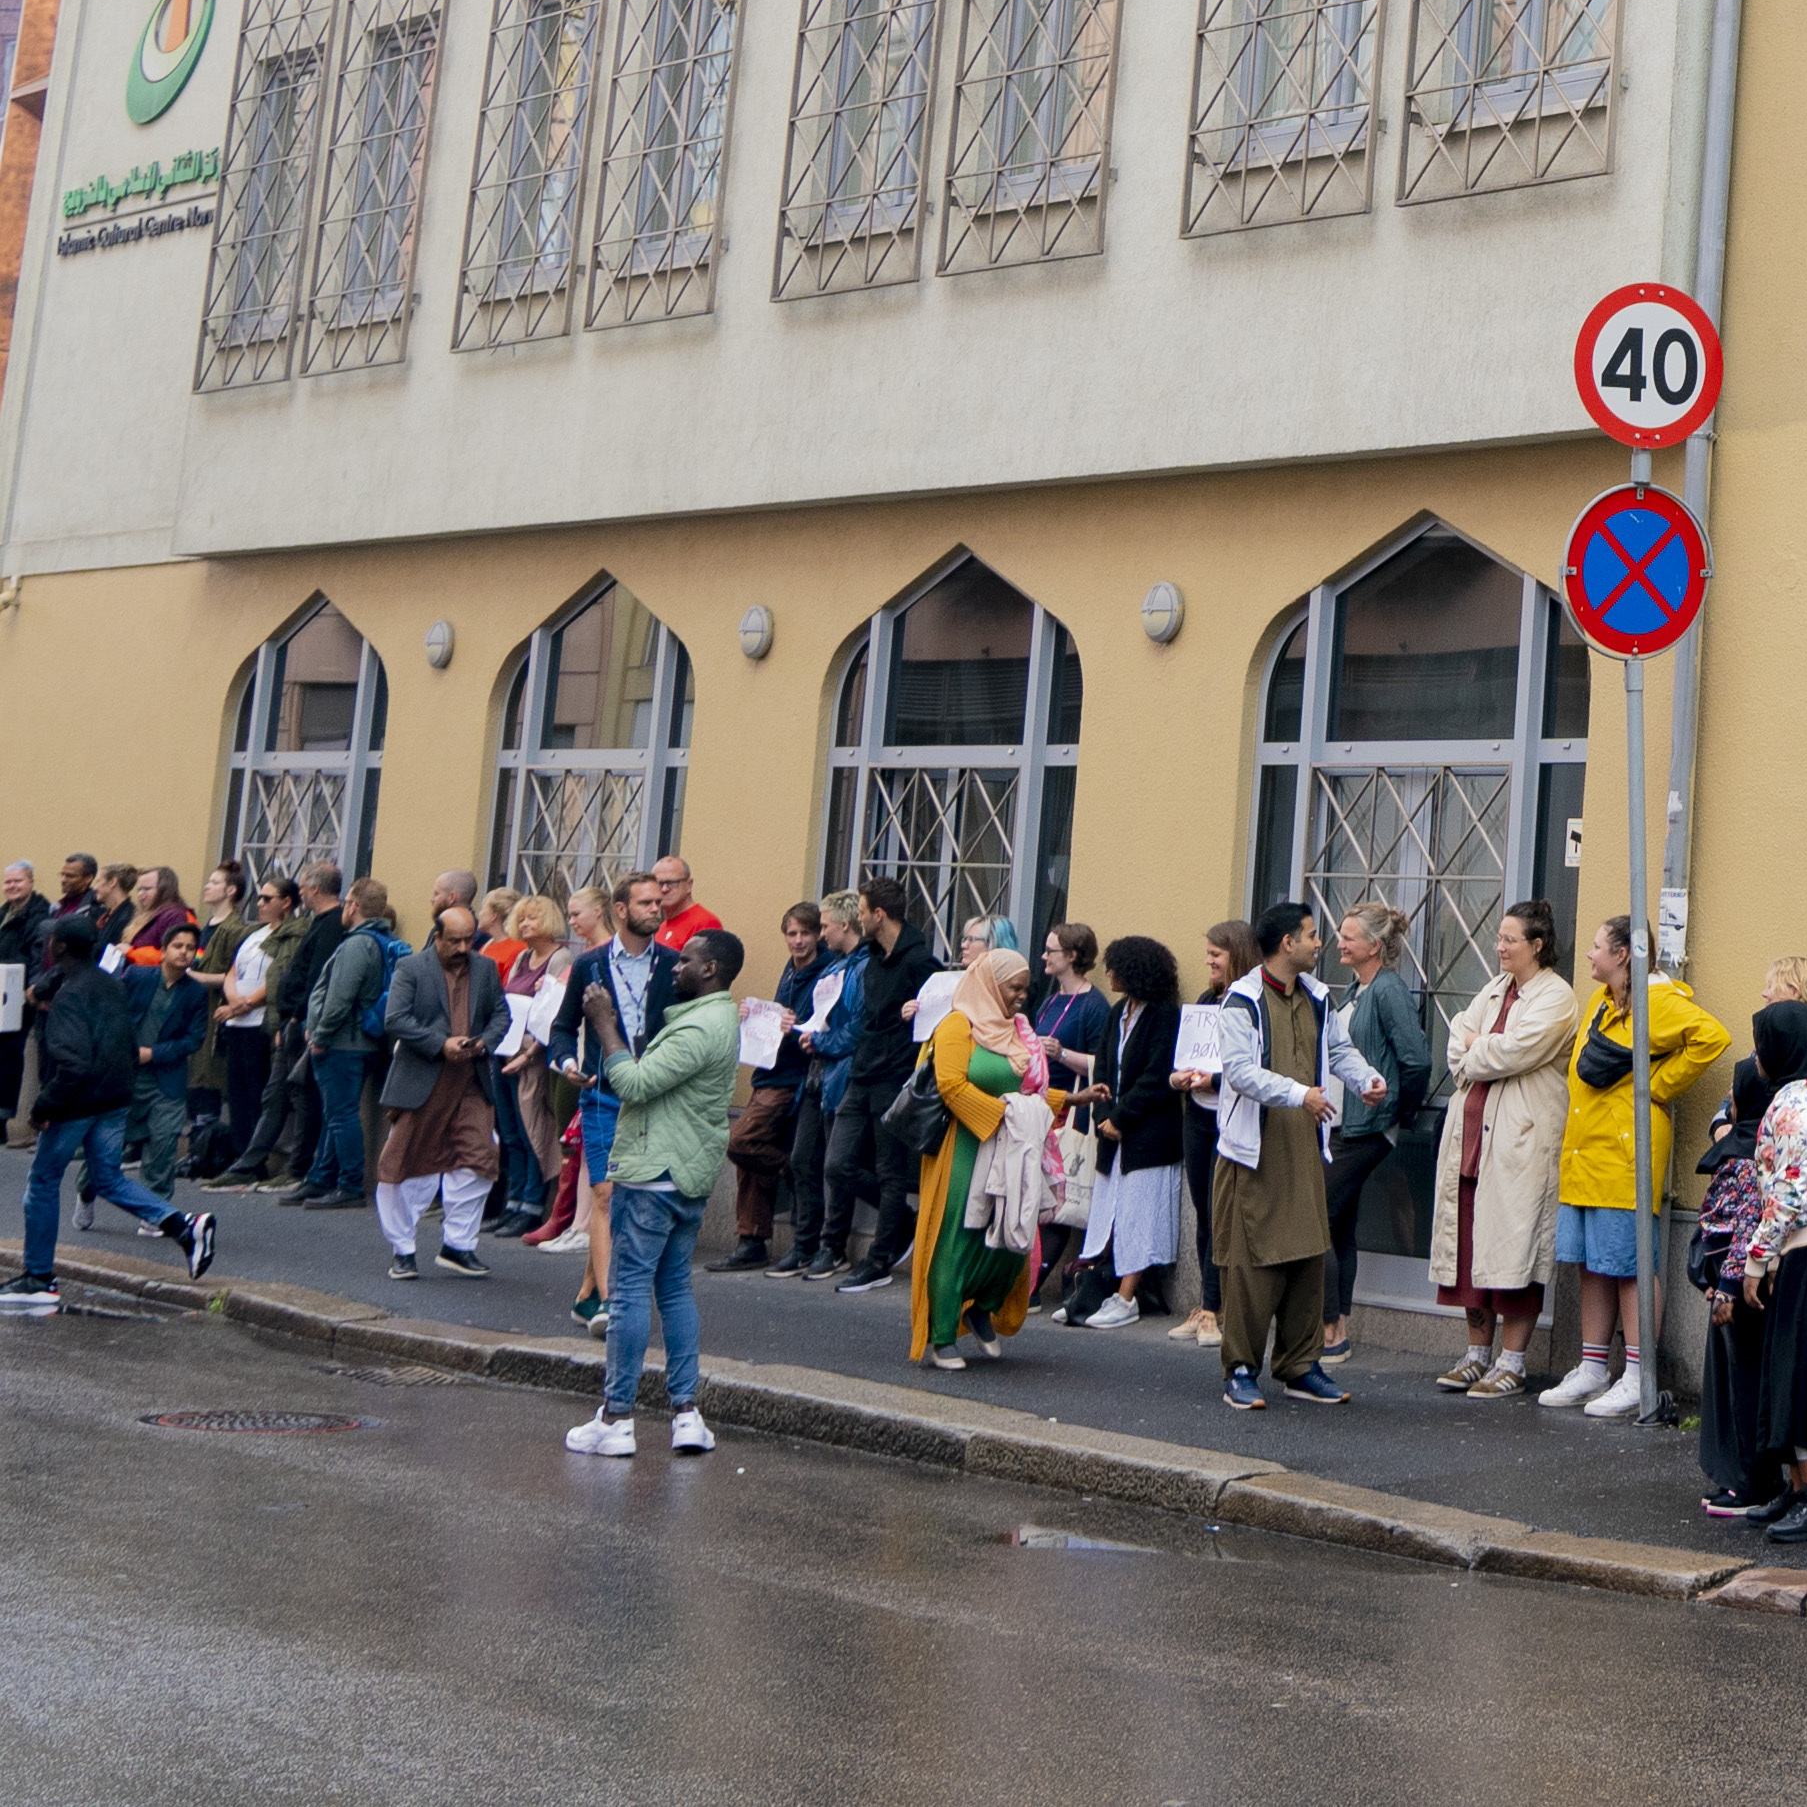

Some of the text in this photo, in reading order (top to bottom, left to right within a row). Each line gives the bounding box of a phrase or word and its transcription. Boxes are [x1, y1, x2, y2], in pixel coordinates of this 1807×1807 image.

[57, 229, 96, 257] Islamic
[98, 217, 143, 248] Cultural
[1601, 327, 1698, 406] 40
[1189, 1042, 1220, 1060] BØN
